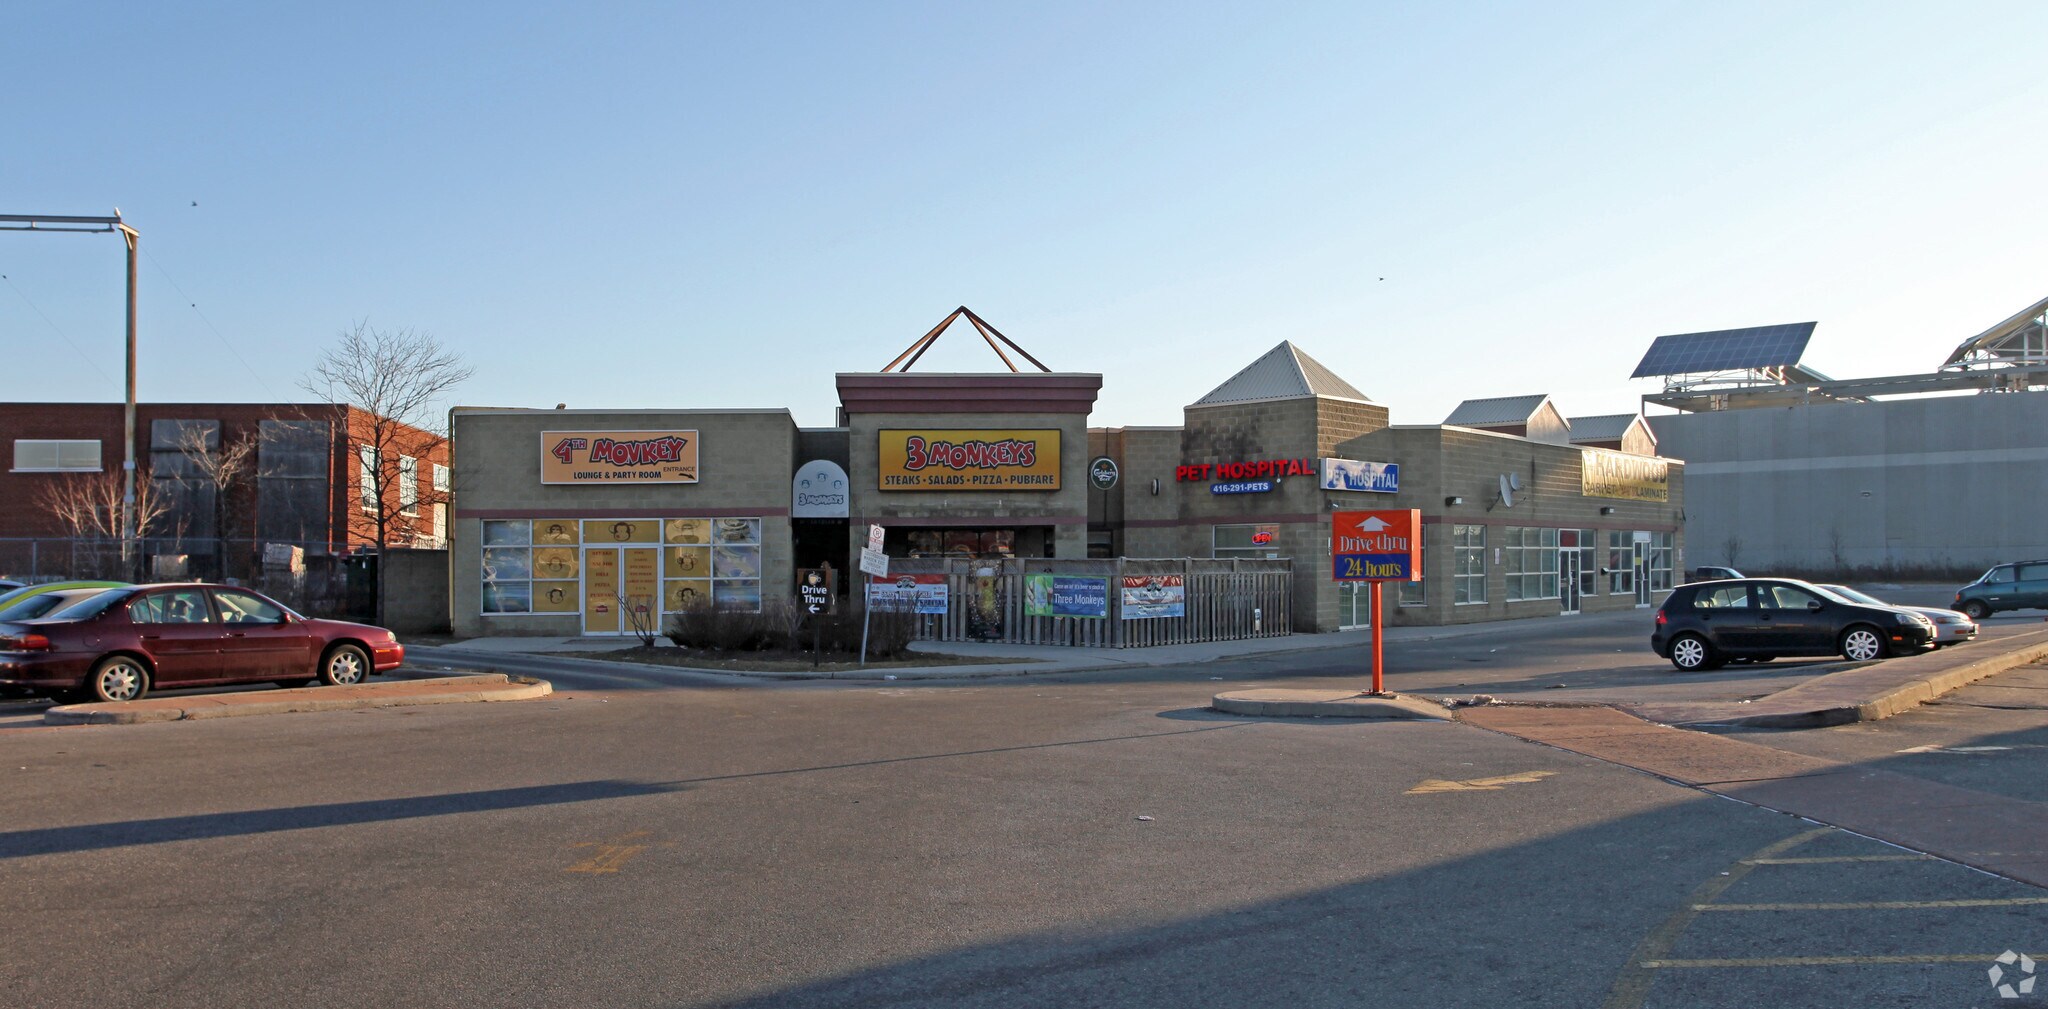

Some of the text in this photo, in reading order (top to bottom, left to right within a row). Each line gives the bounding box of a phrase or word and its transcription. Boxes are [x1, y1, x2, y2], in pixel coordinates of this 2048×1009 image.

[903, 436, 1036, 471] 3 MONKEYS
[612, 471, 637, 479] PARTY
[639, 471, 662, 479] ROOM
[1176, 458, 1315, 482] PET HOSPITAL
[1595, 454, 1667, 484] HARDWOOD
[884, 475, 1054, 485] STEAKS SALADS PIZZA PUBFARE
[1327, 468, 1398, 488] PET HOSPITAL
[1213, 483, 1269, 493] 416-291-PETS
[1637, 486, 1668, 500] LAMINATE
[798, 493, 807, 506] 3
[1340, 534, 1407, 552] Drive thru
[1344, 557, 1402, 577] 24 hours
[801, 585, 828, 594] Drive
[803, 595, 826, 604] Thru
[1054, 593, 1105, 607] Three Monkeys
